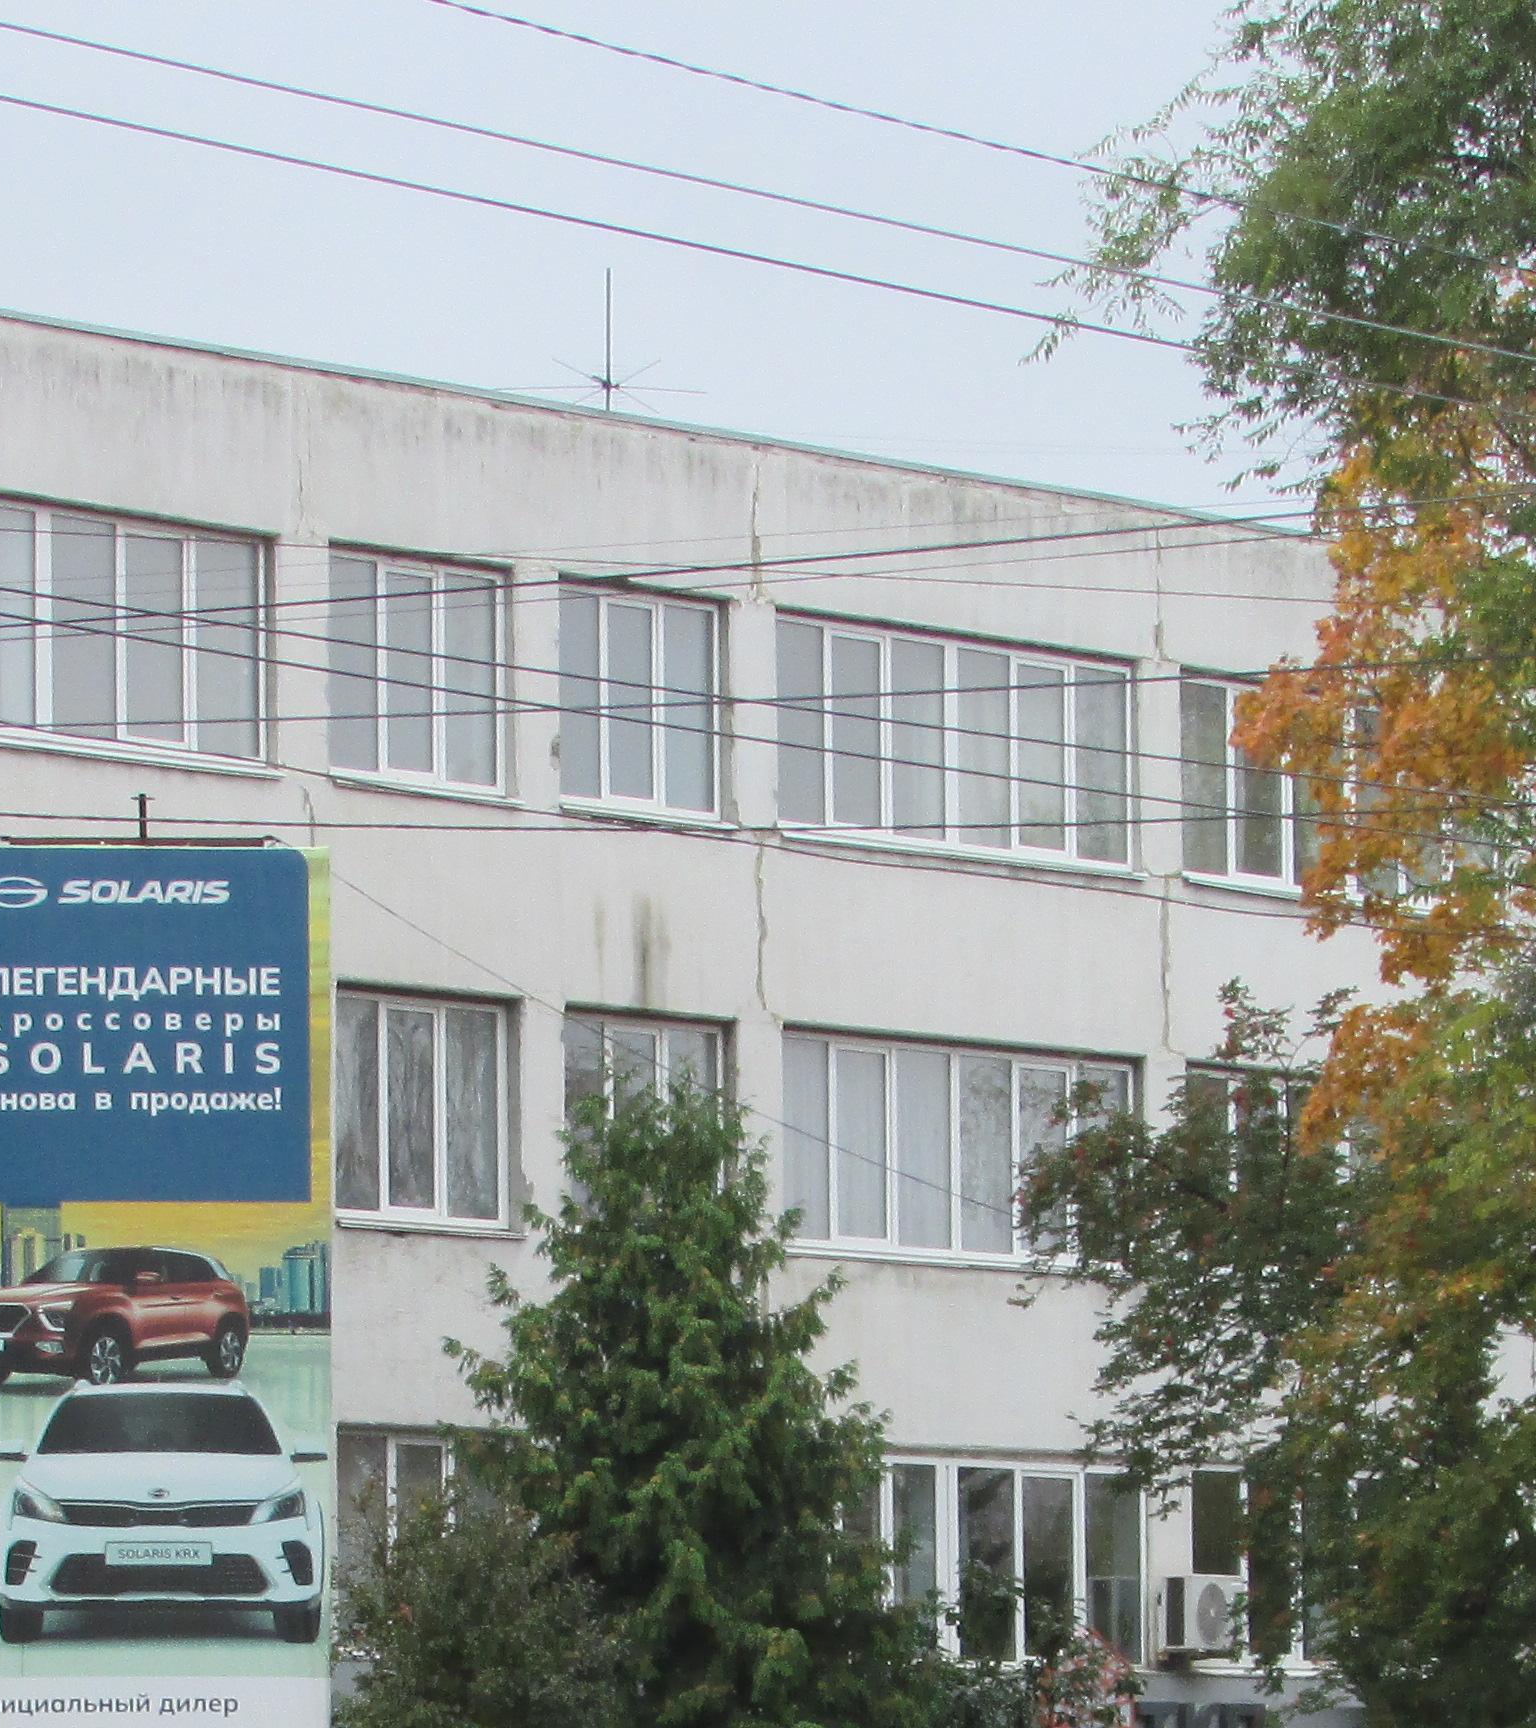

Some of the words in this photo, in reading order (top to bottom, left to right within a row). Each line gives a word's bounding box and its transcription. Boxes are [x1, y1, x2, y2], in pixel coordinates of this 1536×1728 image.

[58, 880, 230, 905] SOLARIS
[95, 1092, 111, 1110] в
[131, 1087, 281, 1116] продаже!
[118, 1547, 172, 1560] SOLARIS
[175, 1547, 201, 1560] KRX
[159, 1697, 239, 1718] дилер
